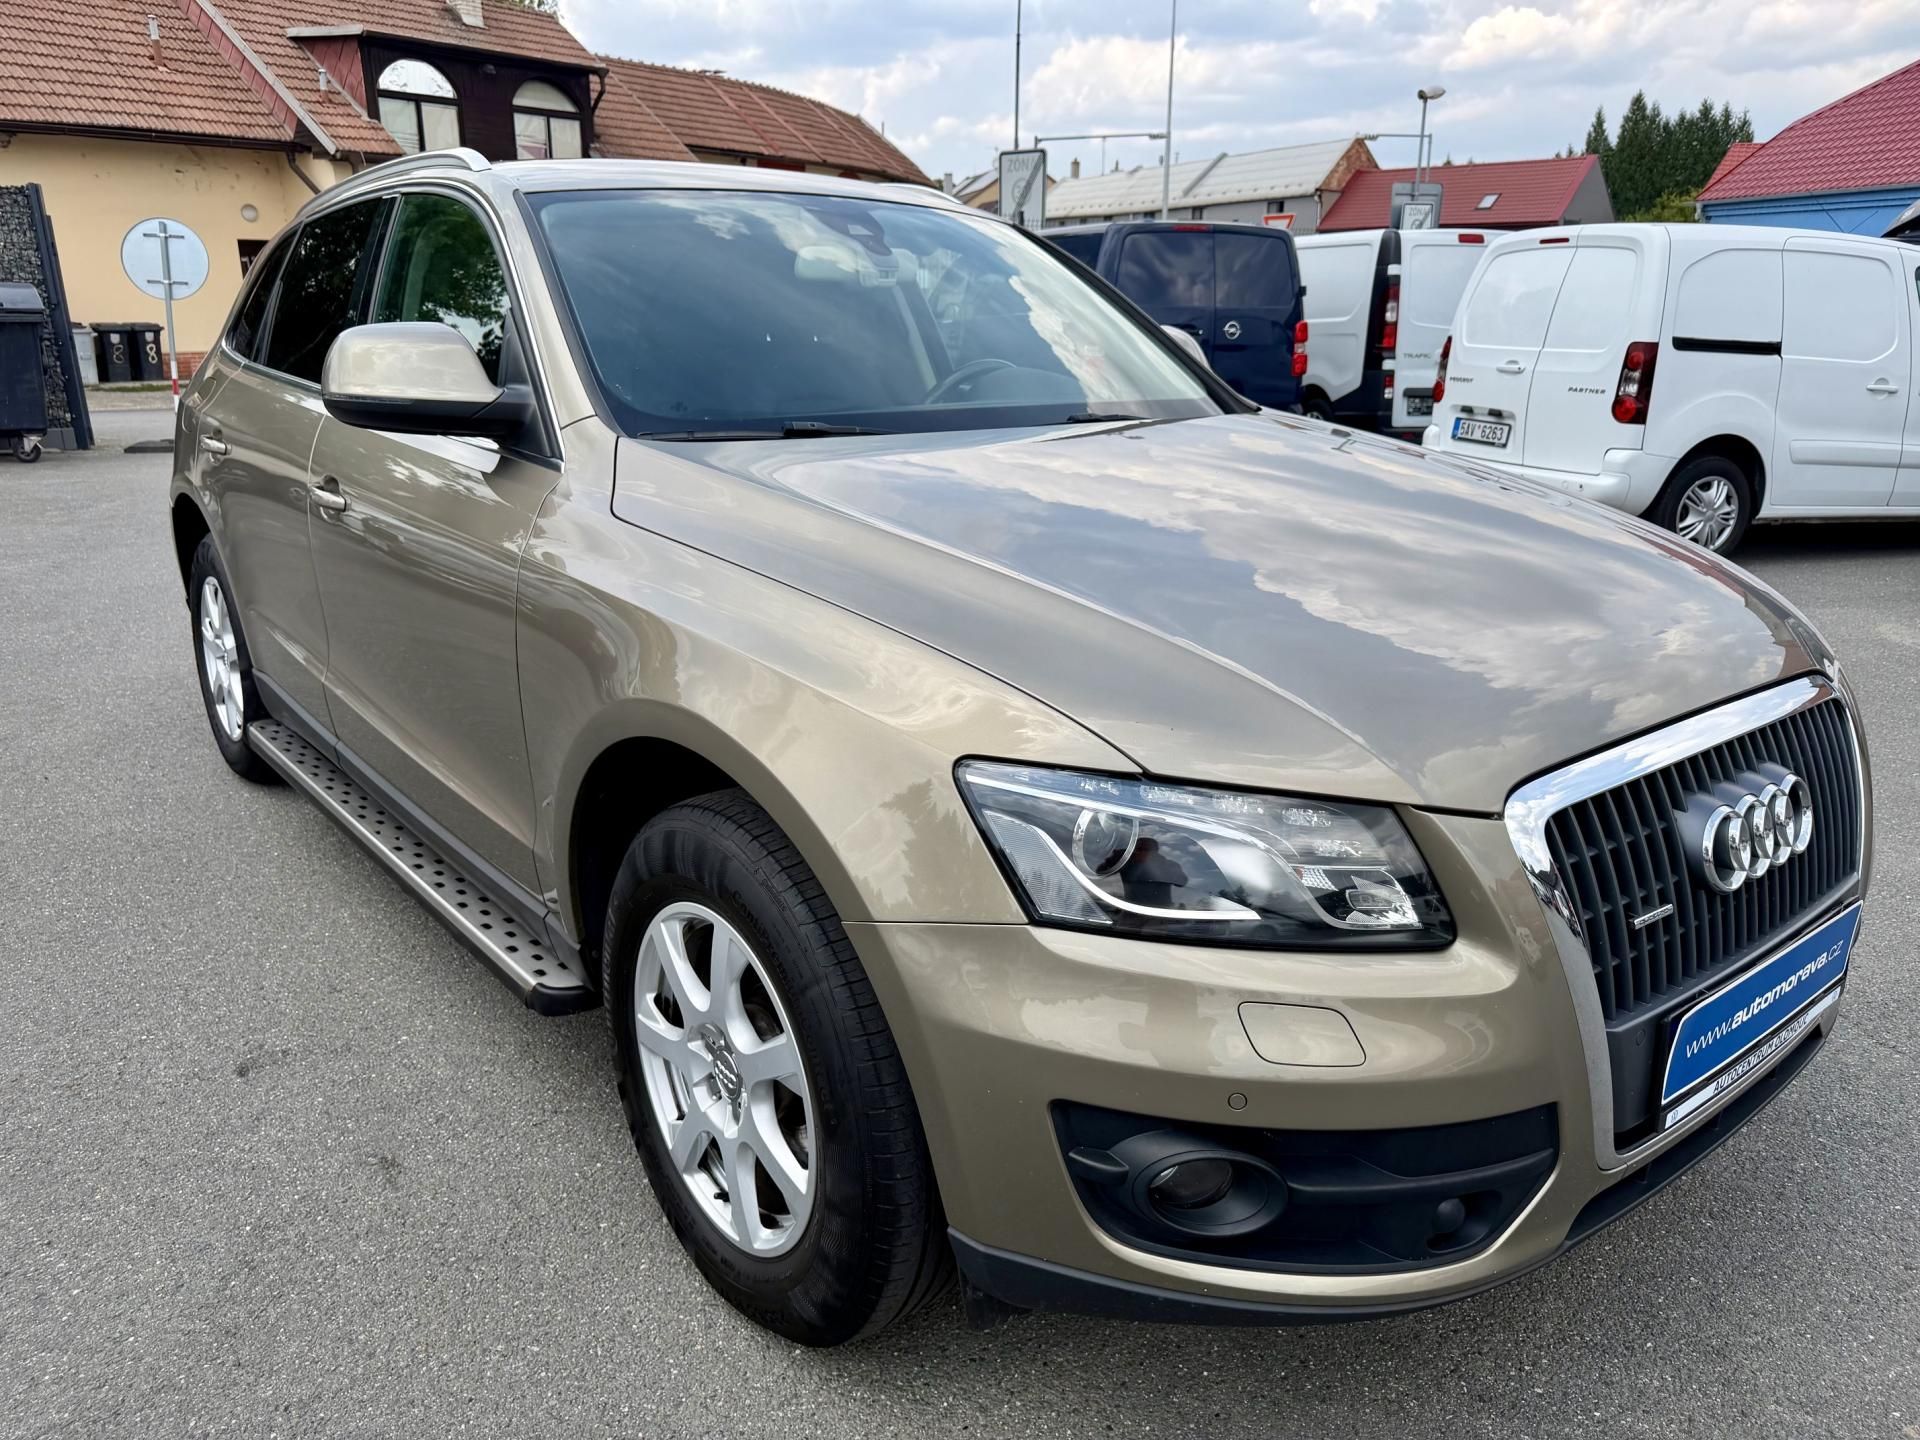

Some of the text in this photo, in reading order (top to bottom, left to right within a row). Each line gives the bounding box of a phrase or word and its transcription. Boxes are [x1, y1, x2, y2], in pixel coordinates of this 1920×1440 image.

[147, 343, 158, 364] 8
[1403, 352, 1432, 360] TRAFIC
[1568, 386, 1606, 395] PARTNER
[1460, 420, 1504, 441] 5AV 6263
[1686, 940, 1843, 1058] www.automorava.cz
